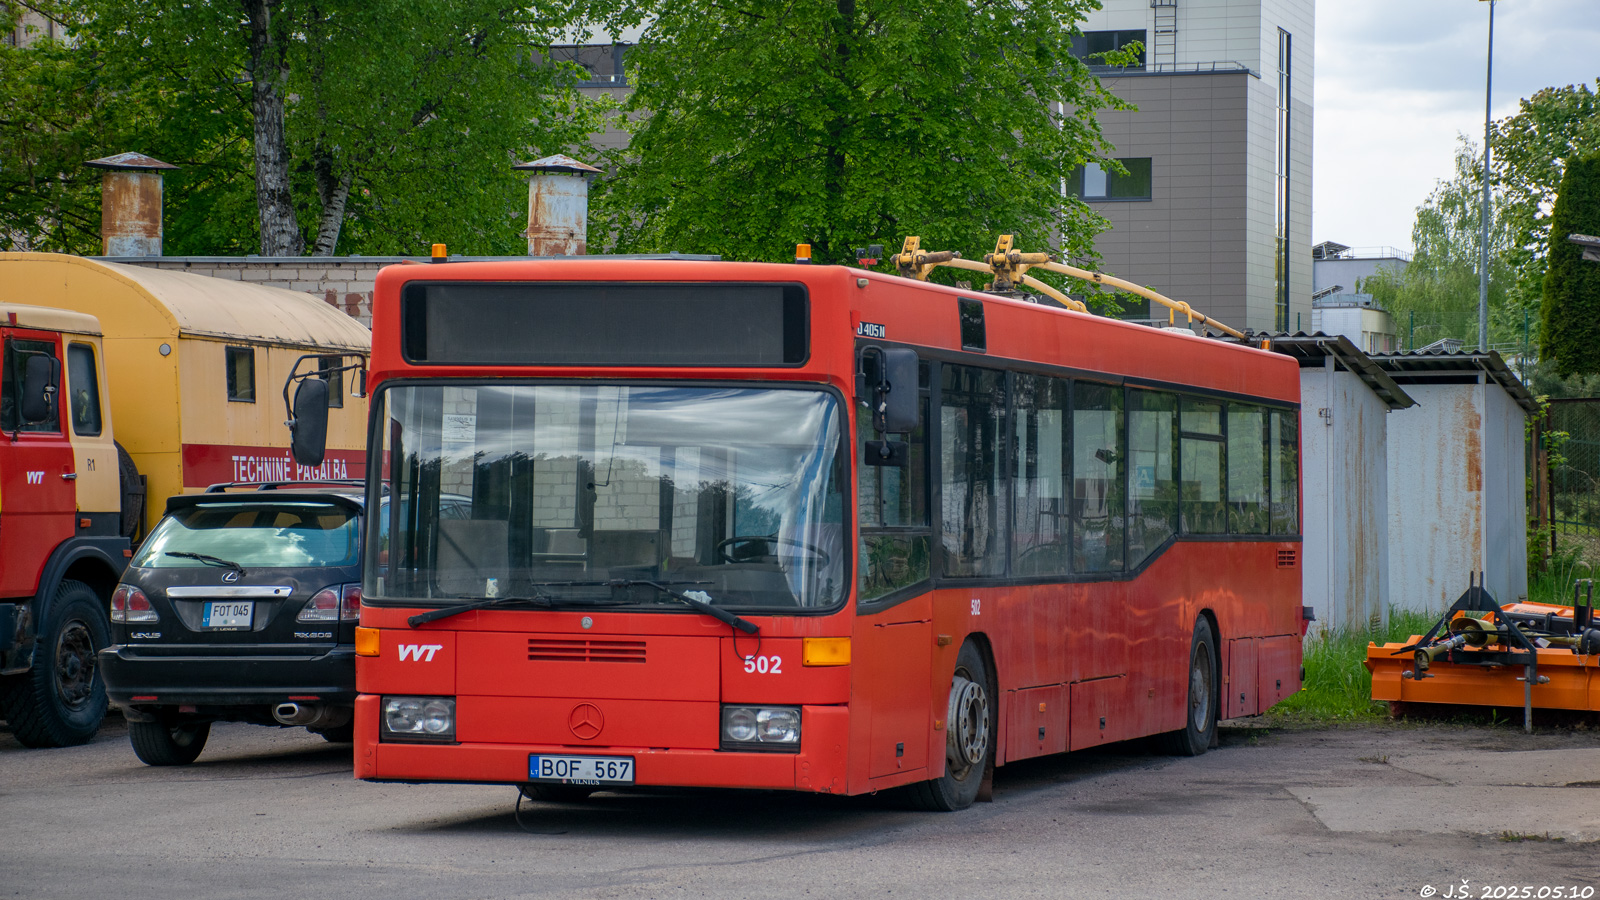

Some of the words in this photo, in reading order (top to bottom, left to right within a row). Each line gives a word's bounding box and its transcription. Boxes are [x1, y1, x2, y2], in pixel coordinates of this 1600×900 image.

[87, 458, 96, 471] R1
[232, 451, 292, 482] TECHNINĖ
[213, 605, 232, 617] FOT
[233, 604, 249, 617] 045
[971, 599, 981, 616] 502
[130, 631, 161, 639] LEXUS
[744, 655, 782, 674] 502
[541, 759, 582, 777] BOF
[595, 760, 630, 780] 567
[570, 778, 600, 786] VILNIUS
